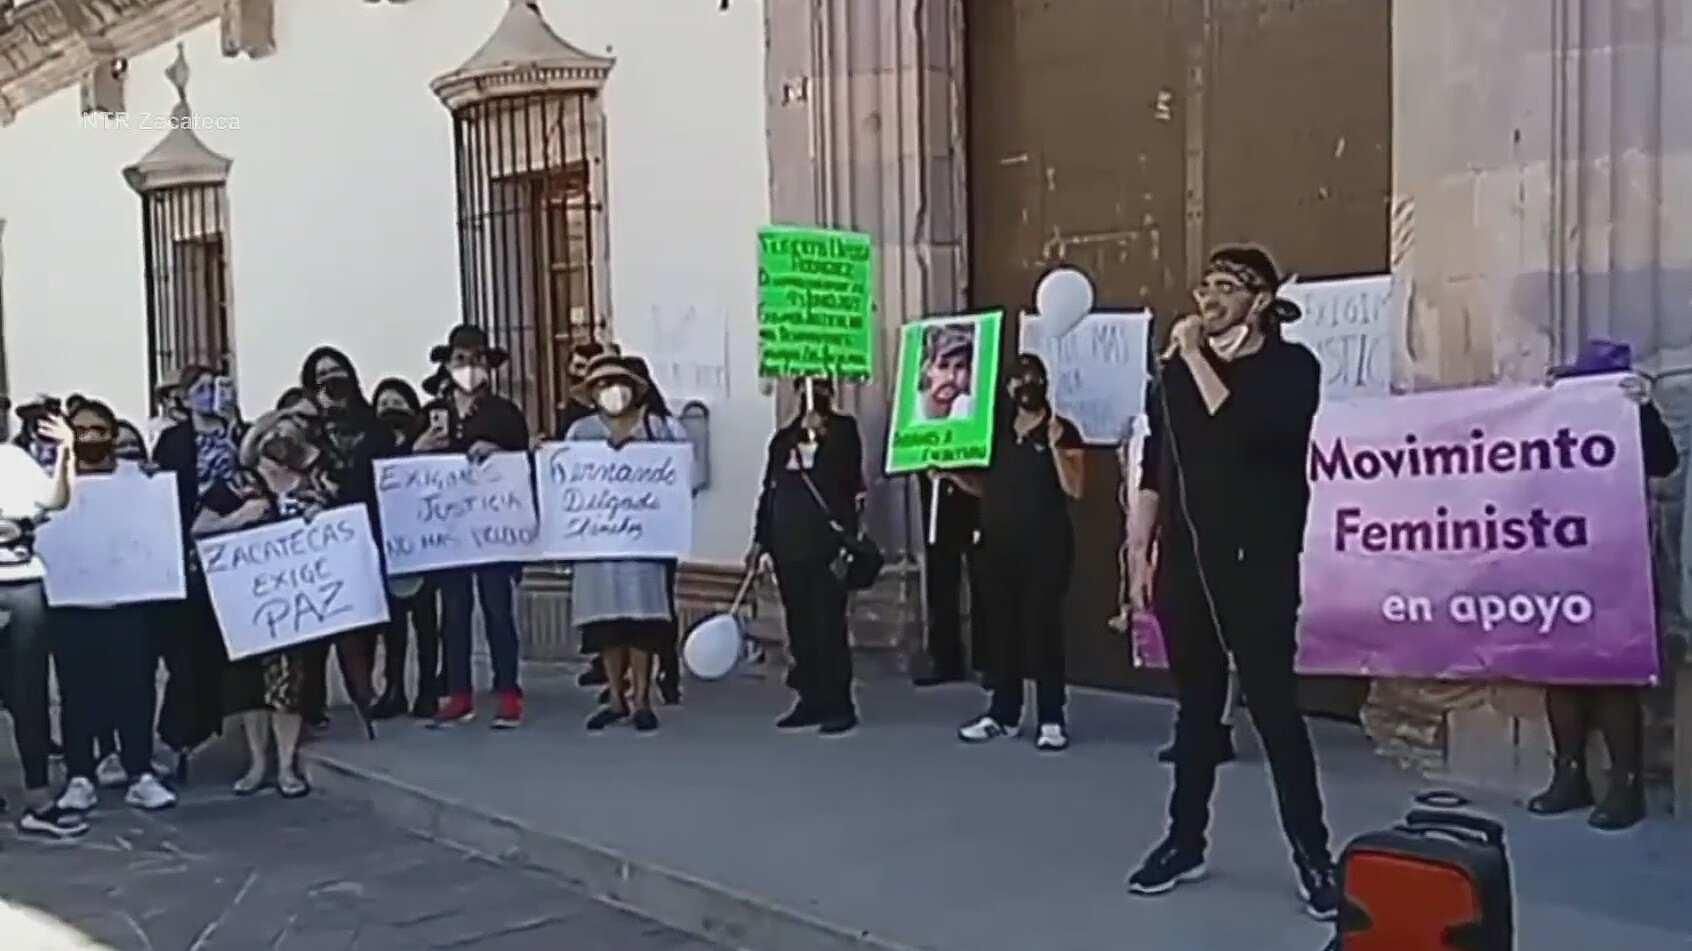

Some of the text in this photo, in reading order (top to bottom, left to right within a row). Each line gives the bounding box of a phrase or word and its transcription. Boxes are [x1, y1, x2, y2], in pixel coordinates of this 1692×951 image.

[1308, 427, 1617, 482] Movimiento
[416, 491, 523, 522] JUSTICIA
[1334, 504, 1589, 553] Feminista
[206, 519, 355, 573] ZACATECAS
[252, 556, 332, 598] EXIGE
[251, 579, 355, 639] PAZ
[1381, 593, 1594, 634] en apoyo
